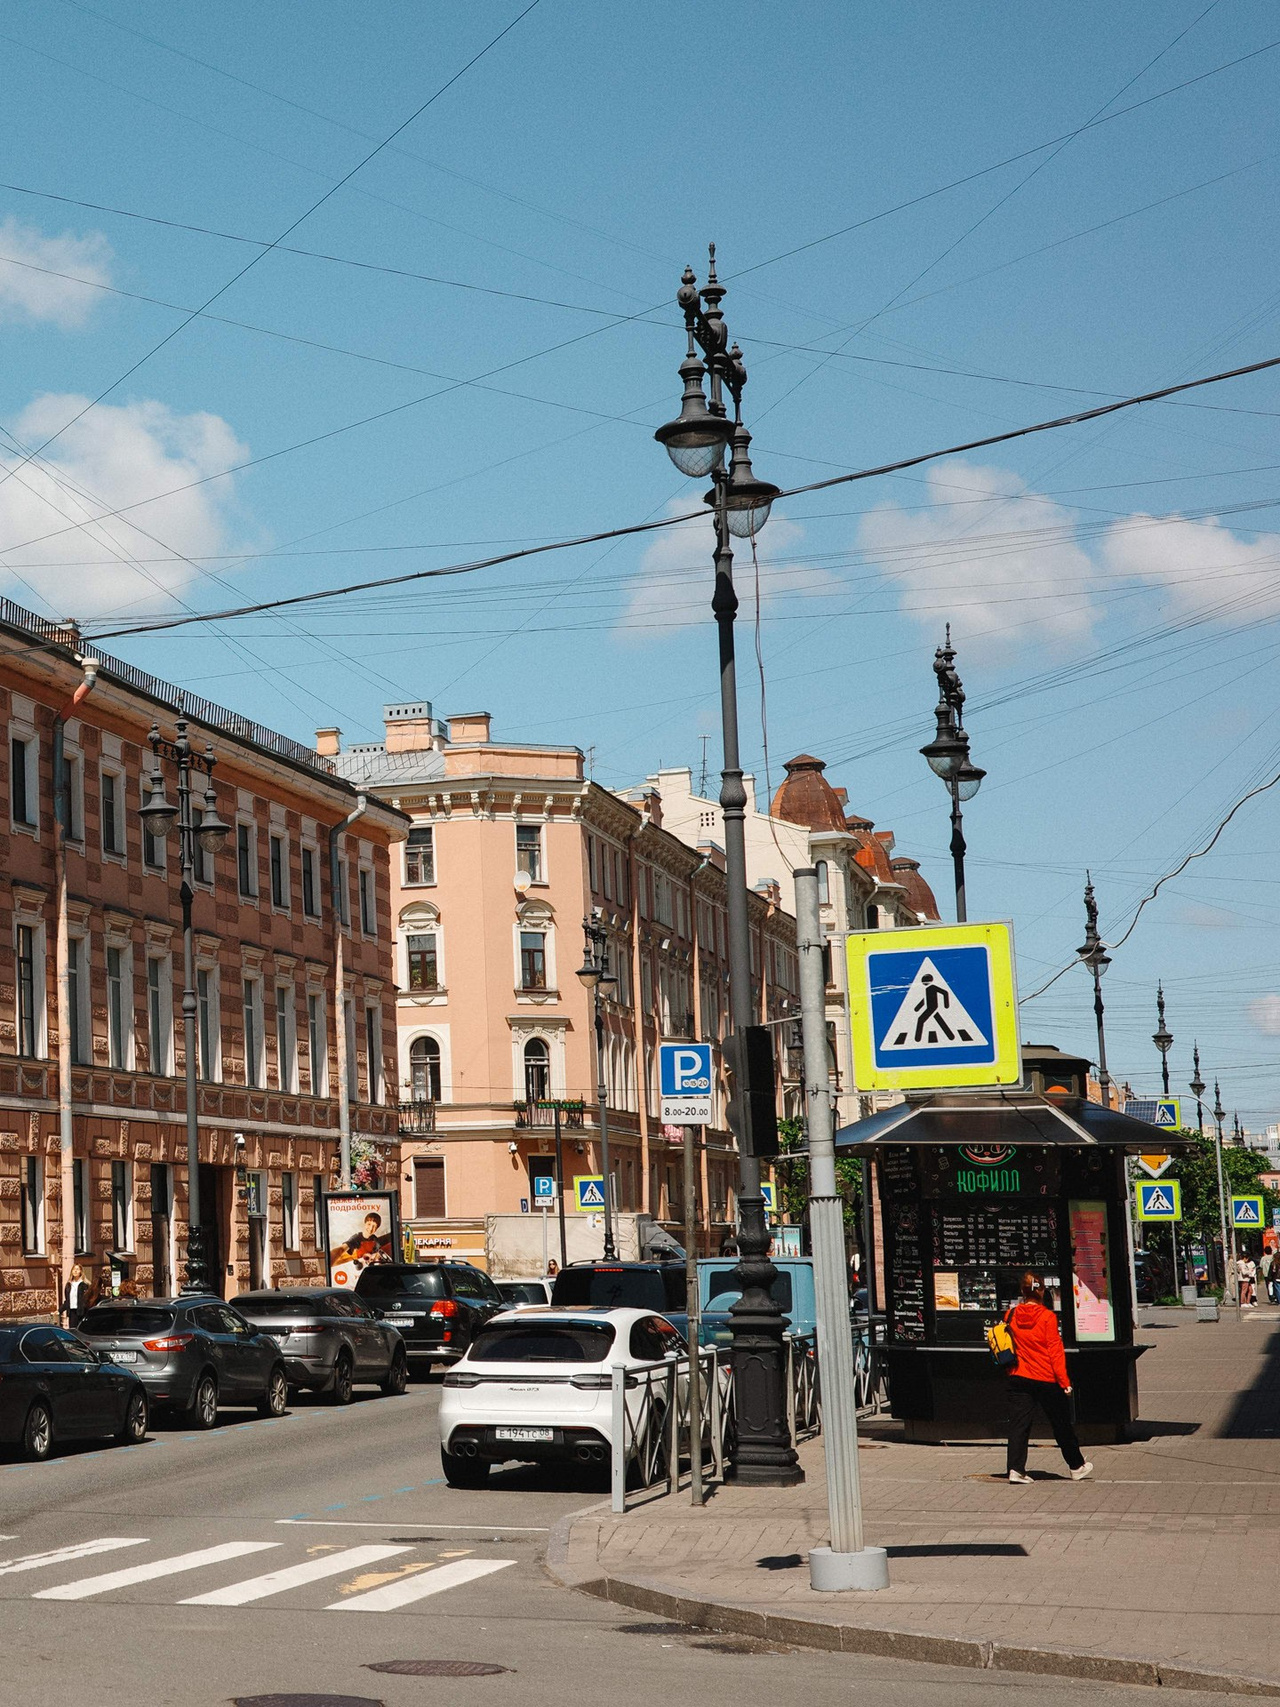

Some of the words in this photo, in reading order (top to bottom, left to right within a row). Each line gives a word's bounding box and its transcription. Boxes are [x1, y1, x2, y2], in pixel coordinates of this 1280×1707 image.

[674, 1050, 702, 1090] P
[698, 1079, 708, 1087] 20
[664, 1106, 708, 1117] 8.00-20.00
[540, 1179, 550, 1194] P
[957, 1169, 1020, 1193] КОФИЛЛ
[330, 1204, 381, 1213] подработку
